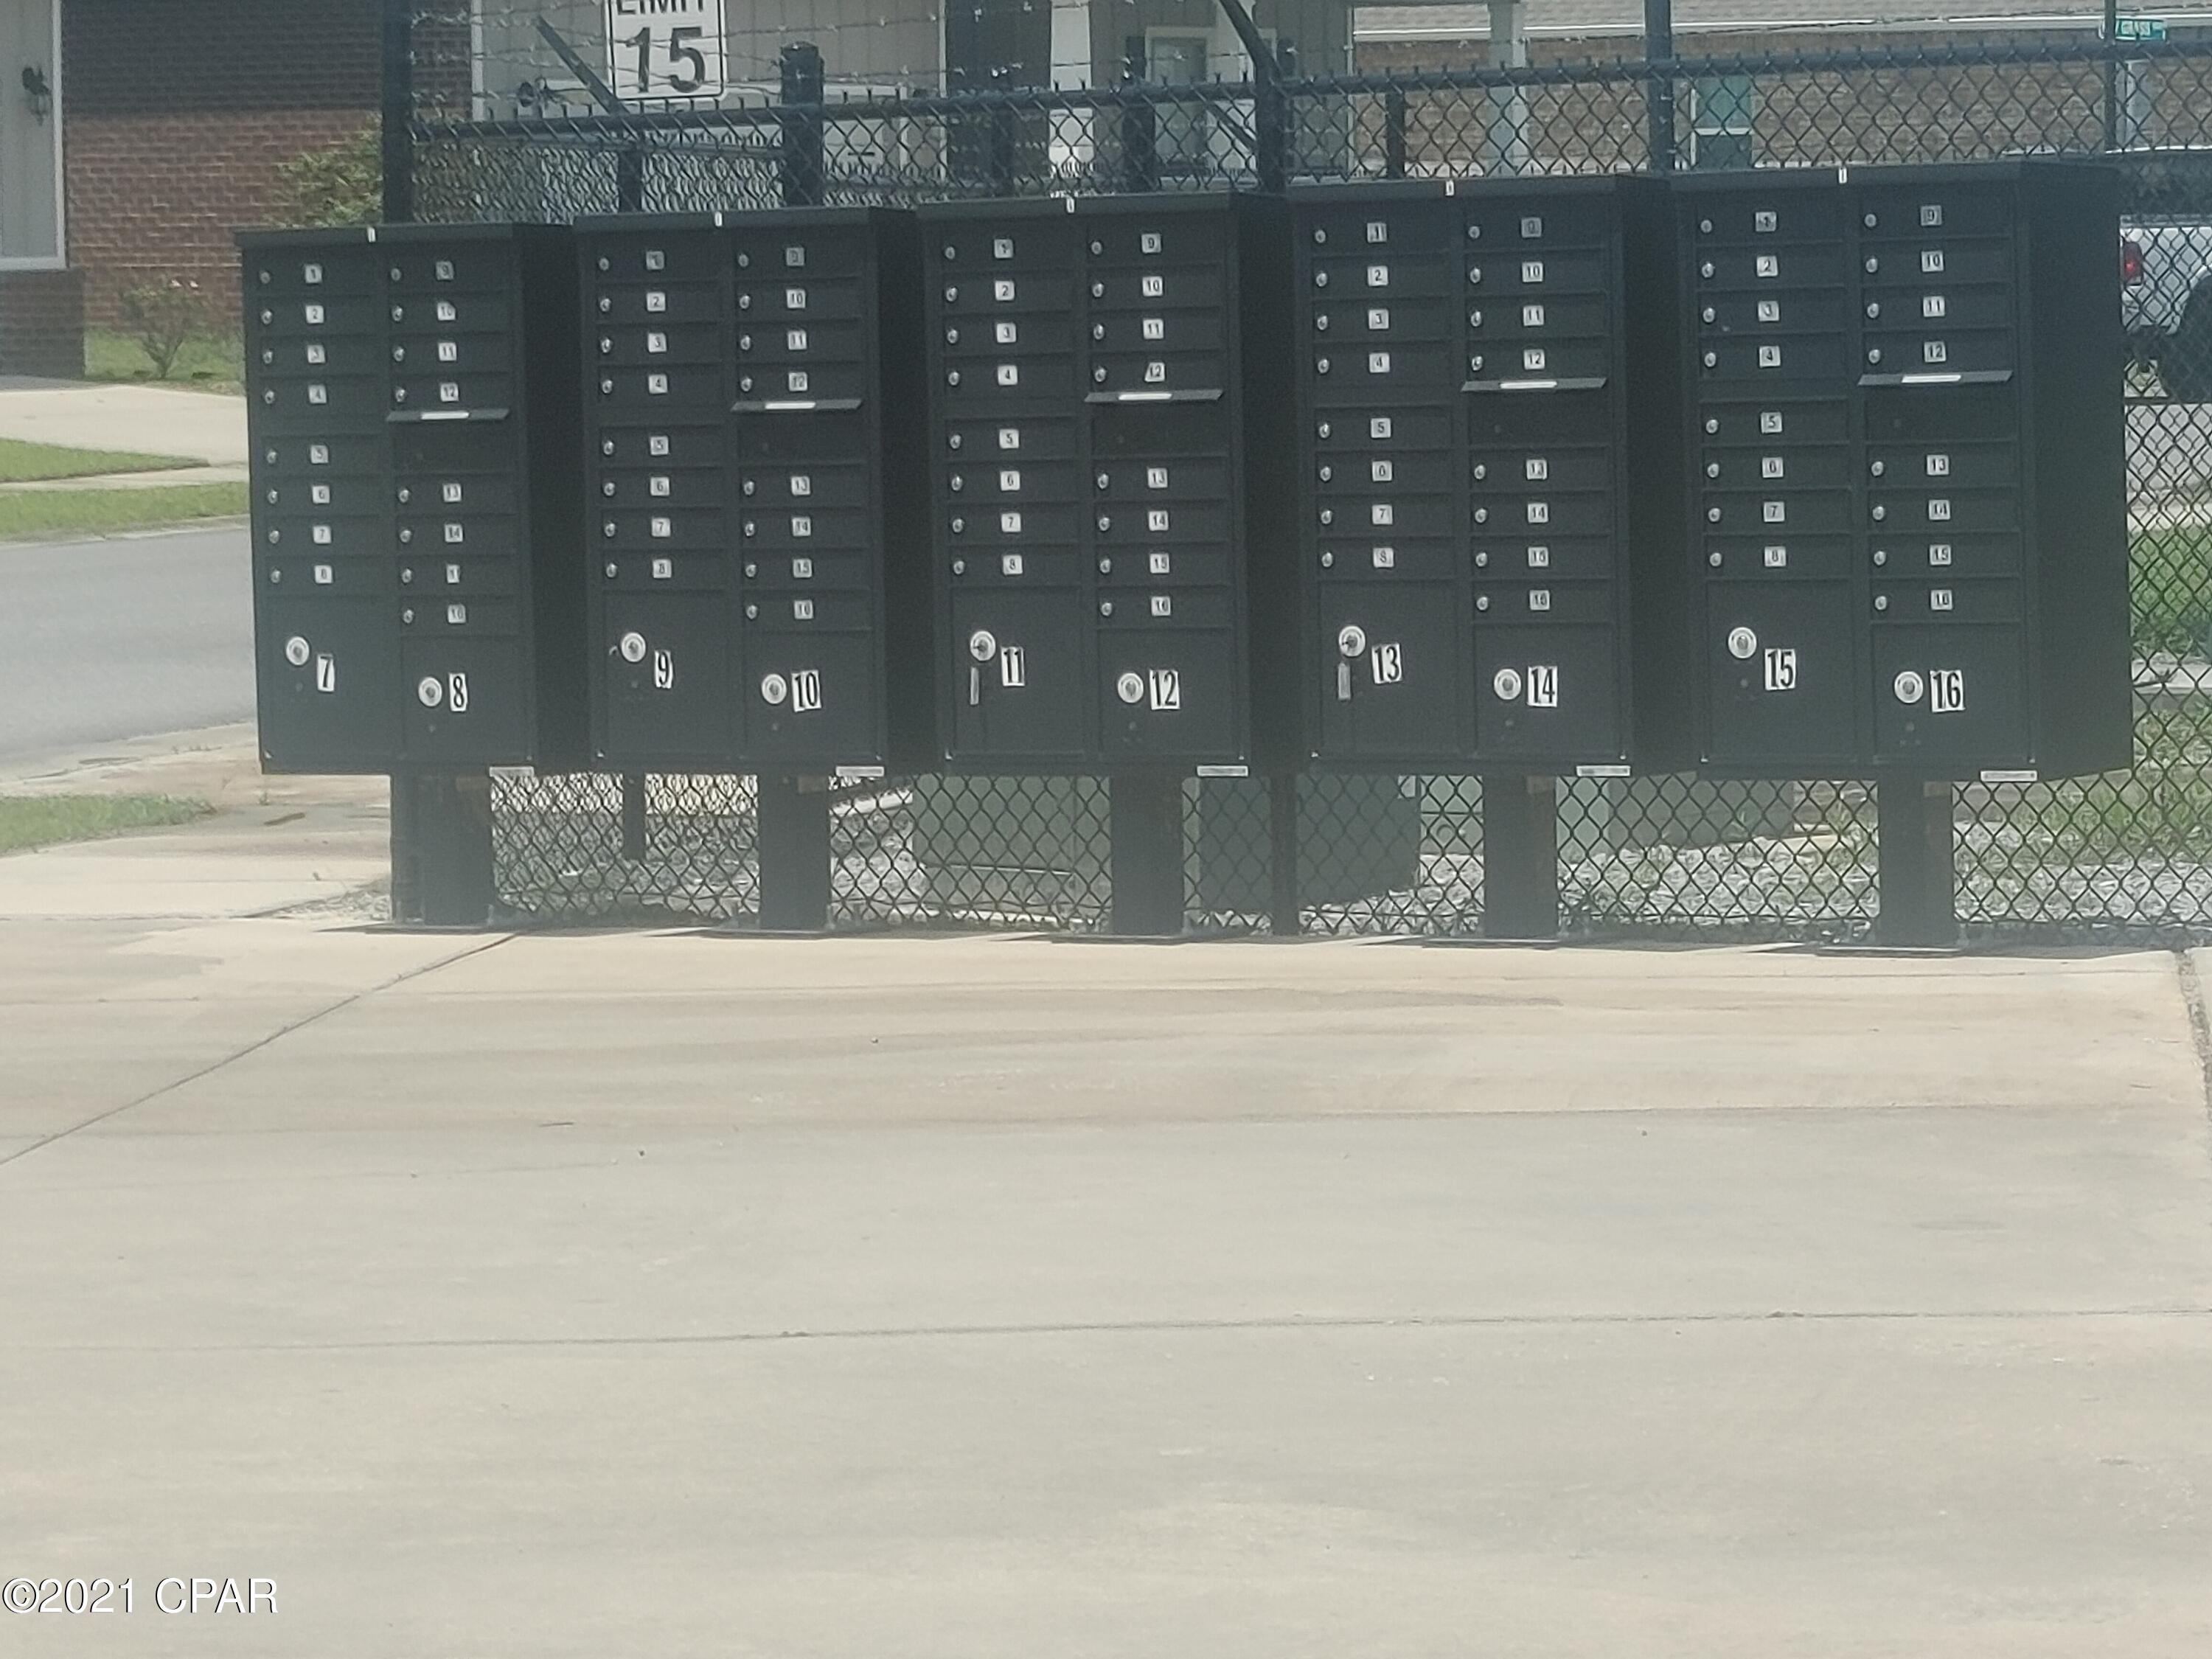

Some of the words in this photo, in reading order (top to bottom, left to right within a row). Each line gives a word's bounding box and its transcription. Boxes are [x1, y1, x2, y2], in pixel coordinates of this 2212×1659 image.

[626, 27, 706, 94] 15
[320, 655, 333, 689] 7
[658, 651, 669, 686] 9
[1003, 647, 1023, 684] 11
[1374, 645, 1400, 681] 13
[1767, 650, 1795, 689] 15
[452, 675, 465, 708] 8
[793, 672, 819, 708] 10
[1152, 671, 1178, 707] 12
[1530, 667, 1556, 704] 14
[1933, 672, 1961, 709] 16
